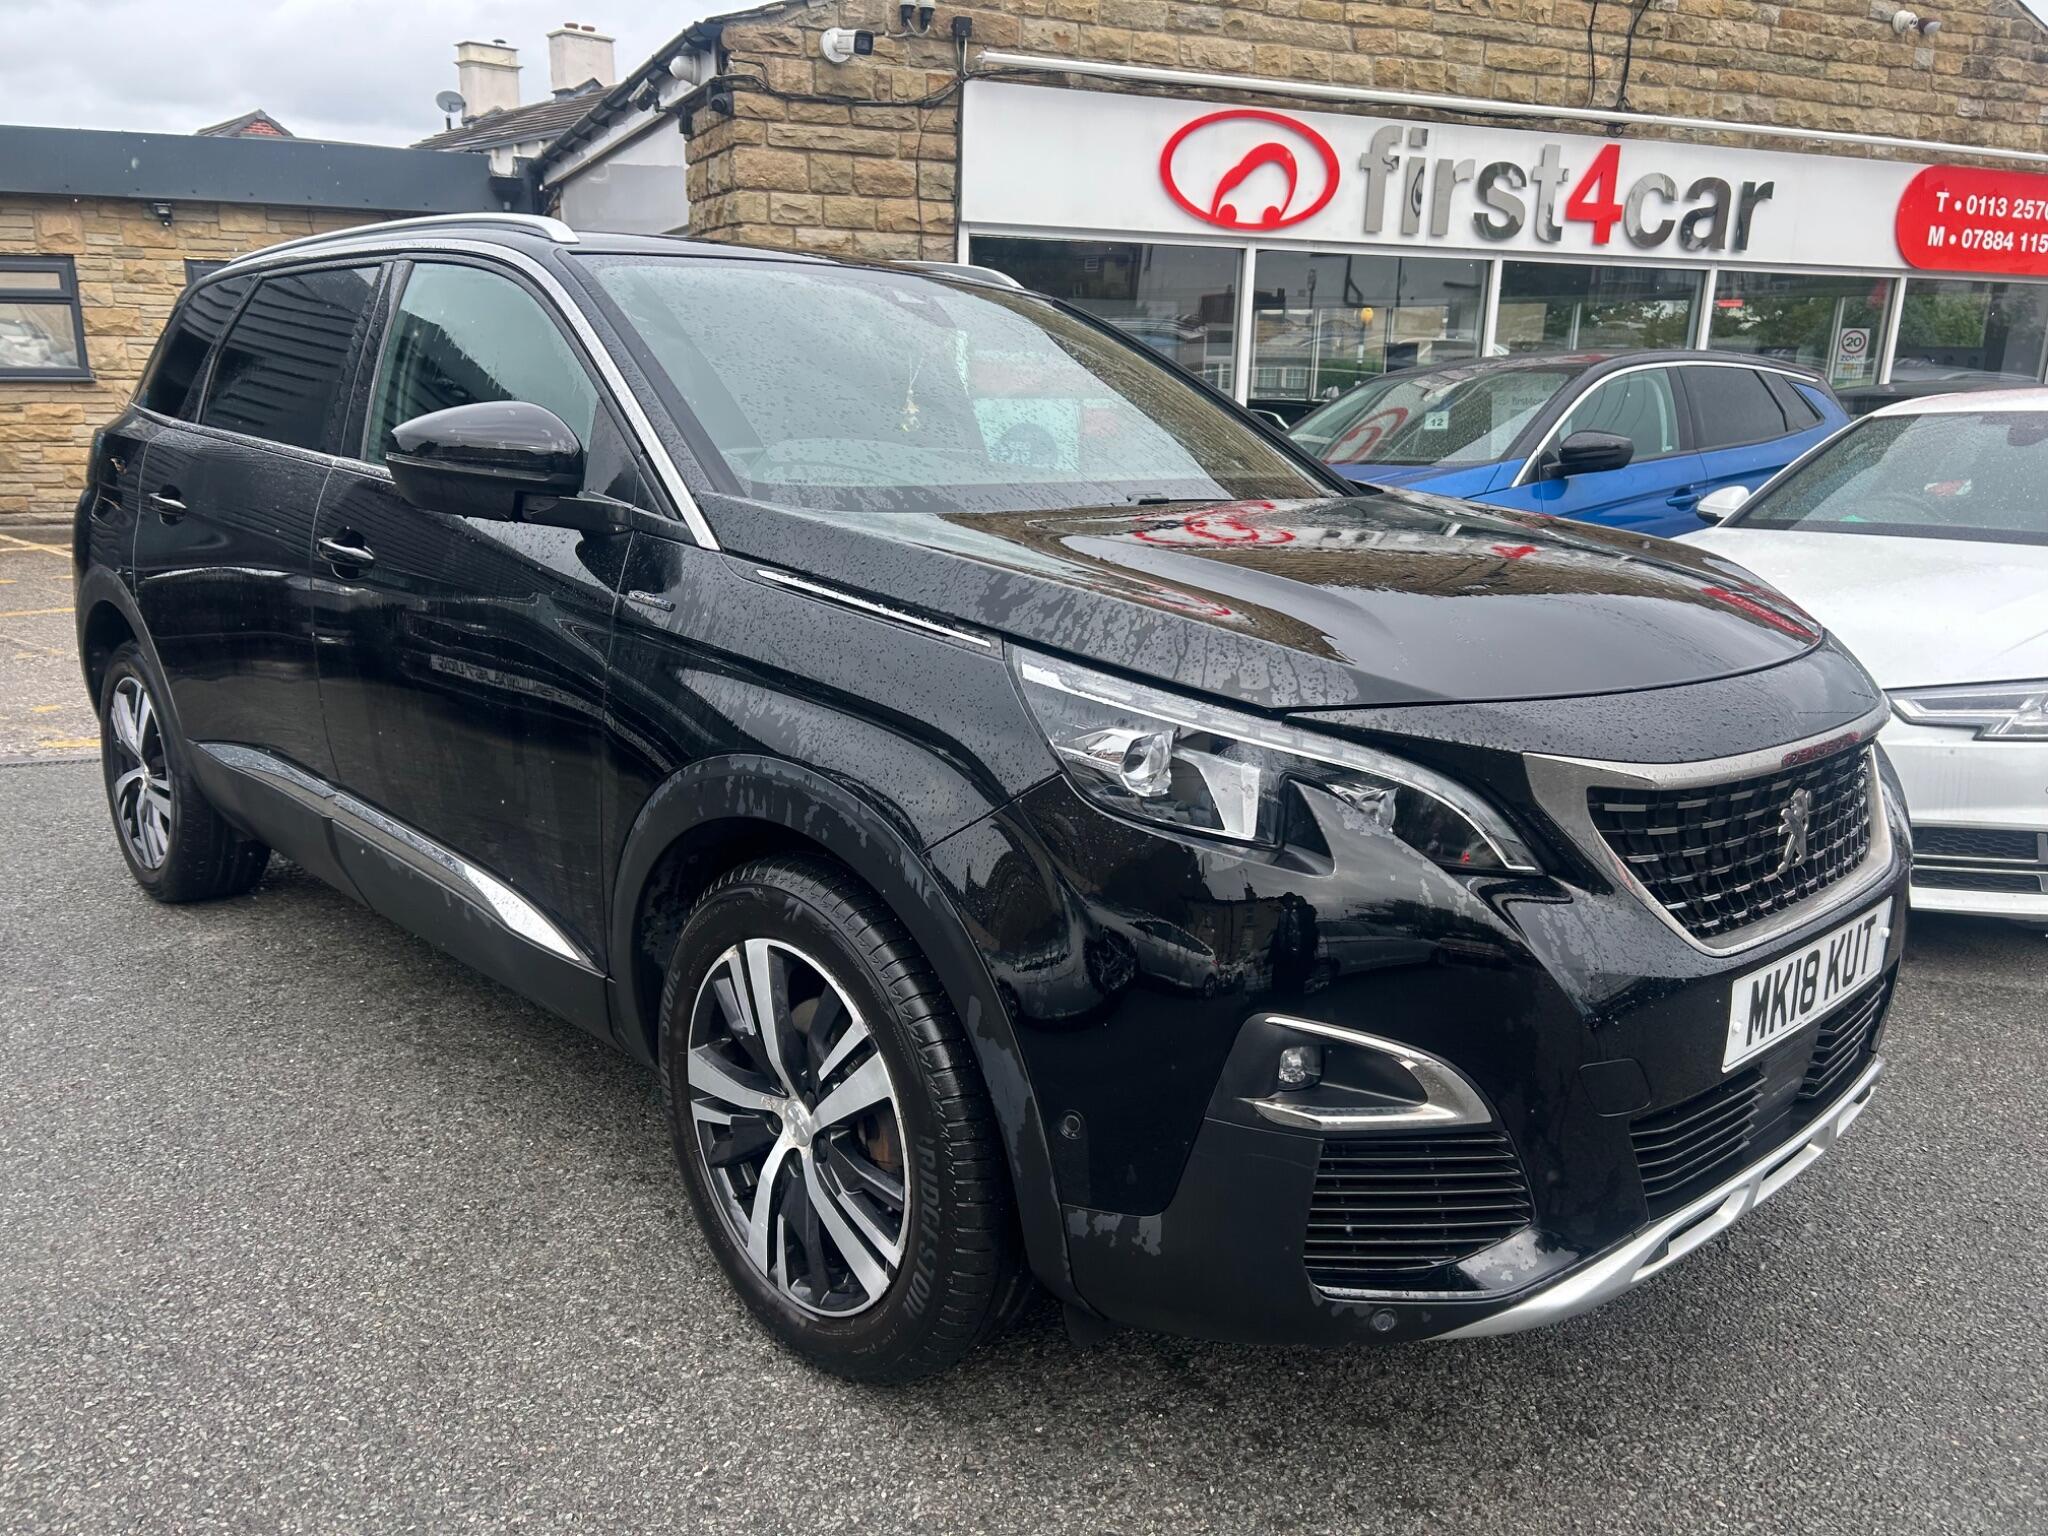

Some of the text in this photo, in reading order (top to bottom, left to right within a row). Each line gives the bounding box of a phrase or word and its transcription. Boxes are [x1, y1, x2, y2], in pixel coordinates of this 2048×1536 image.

[1360, 125, 1775, 252] first4car
[1936, 191, 1950, 213] T
[1966, 195, 2008, 217] 0113
[1927, 225, 2048, 254] M 07884 115
[1845, 336, 1863, 348] 20
[1430, 418, 1445, 428] 12
[1745, 913, 1878, 1048] MK18 KUT
